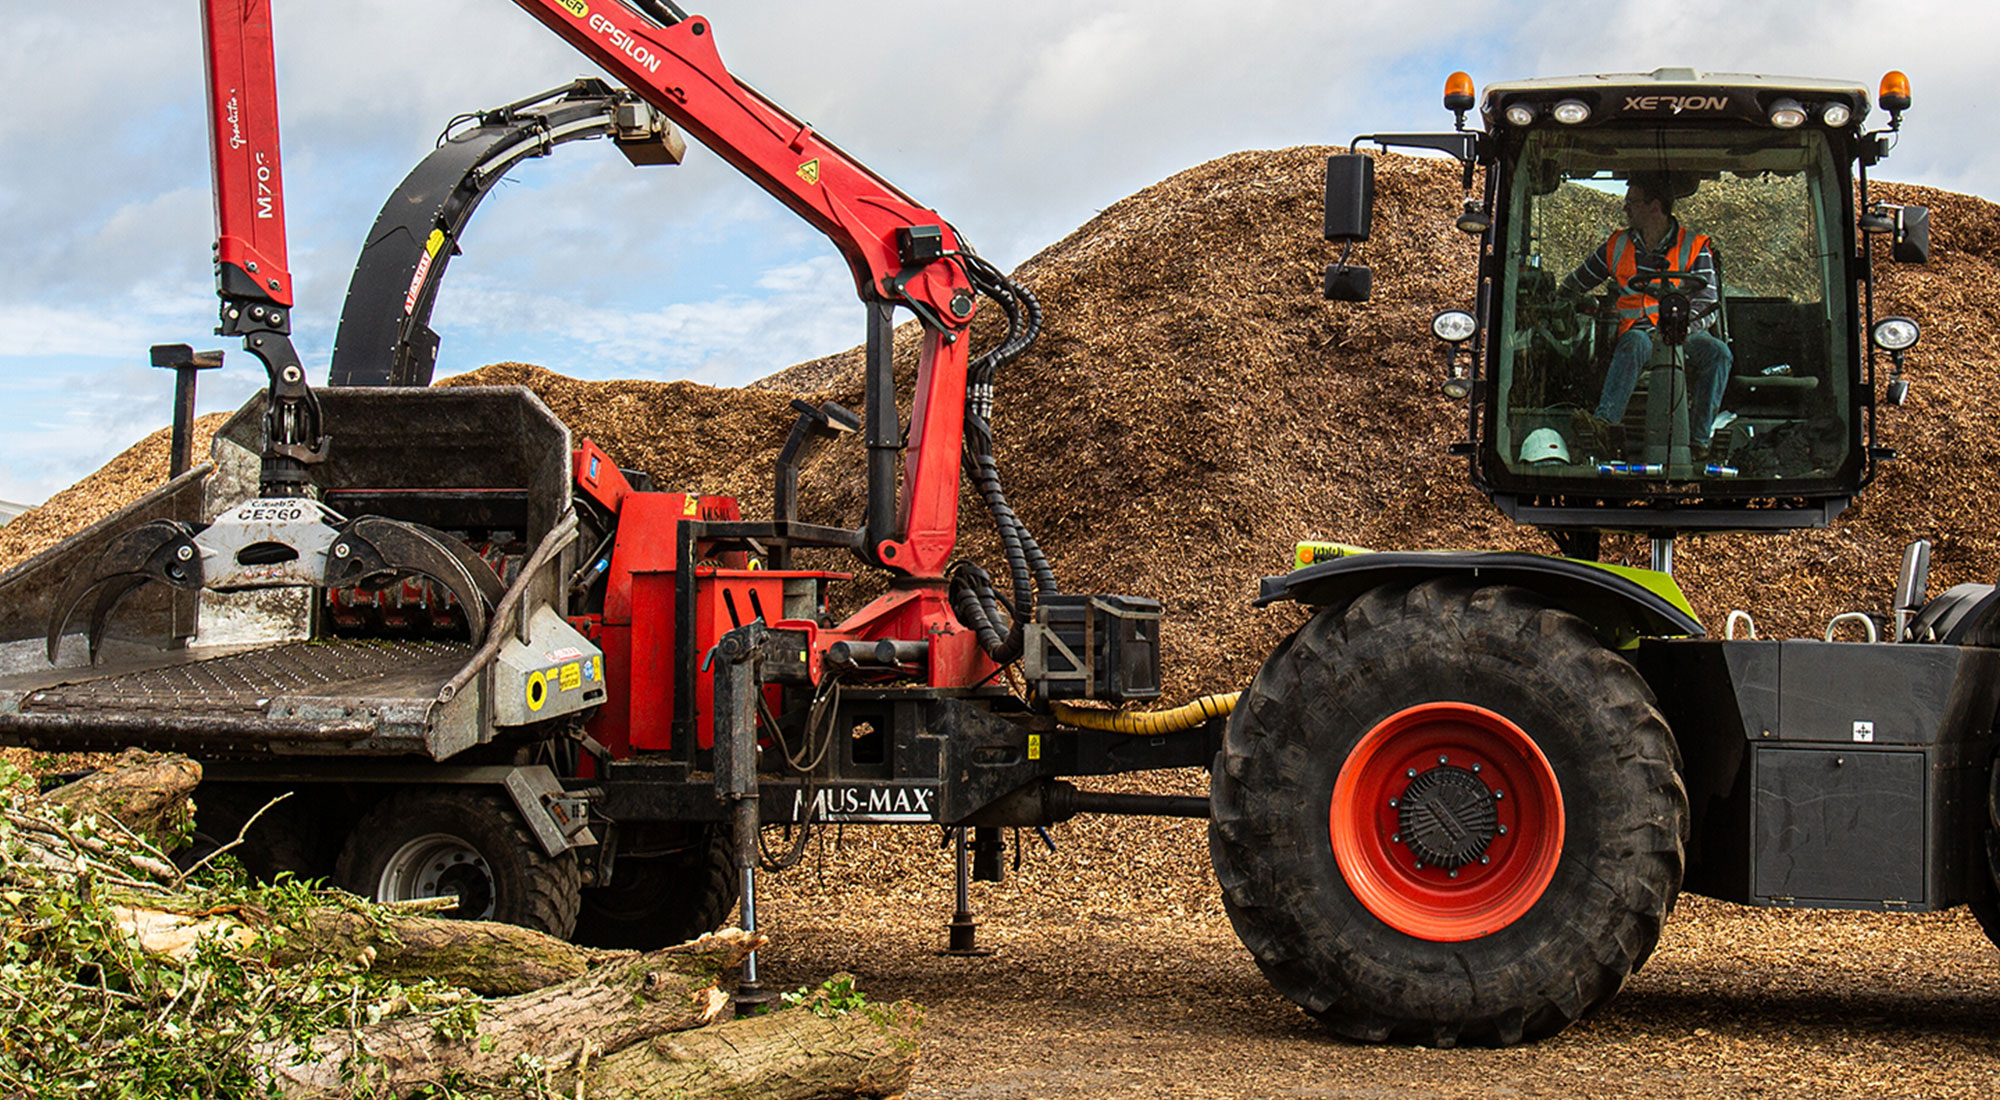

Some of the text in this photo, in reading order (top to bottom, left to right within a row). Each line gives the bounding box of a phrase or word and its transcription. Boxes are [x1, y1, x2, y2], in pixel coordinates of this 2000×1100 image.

[589, 13, 661, 73] EPSILON
[1623, 96, 1729, 111] XERION
[238, 508, 302, 520] CE360
[792, 788, 930, 821] MUS-MAX
